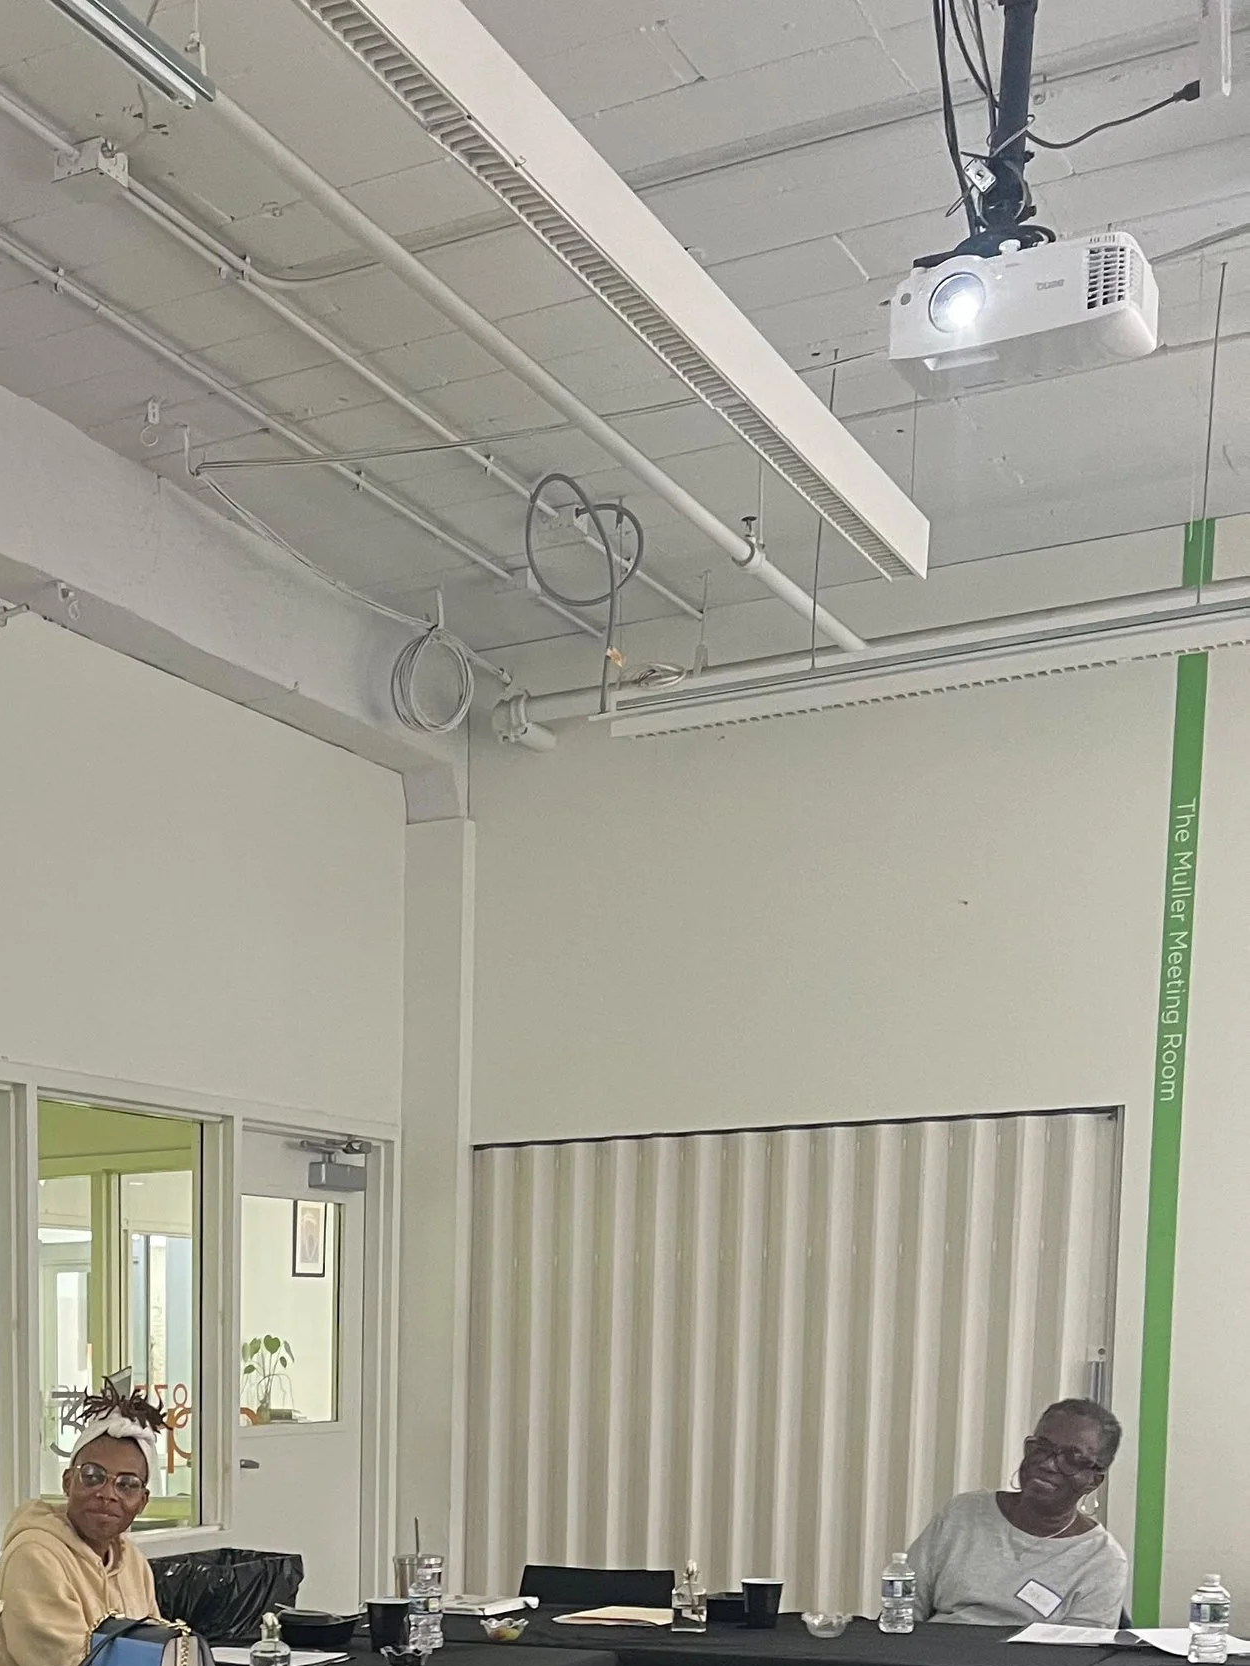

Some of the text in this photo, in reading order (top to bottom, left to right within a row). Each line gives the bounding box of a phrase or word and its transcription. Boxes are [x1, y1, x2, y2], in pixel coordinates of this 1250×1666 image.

[1159, 797, 1196, 1102] The Muller Meeting Room
